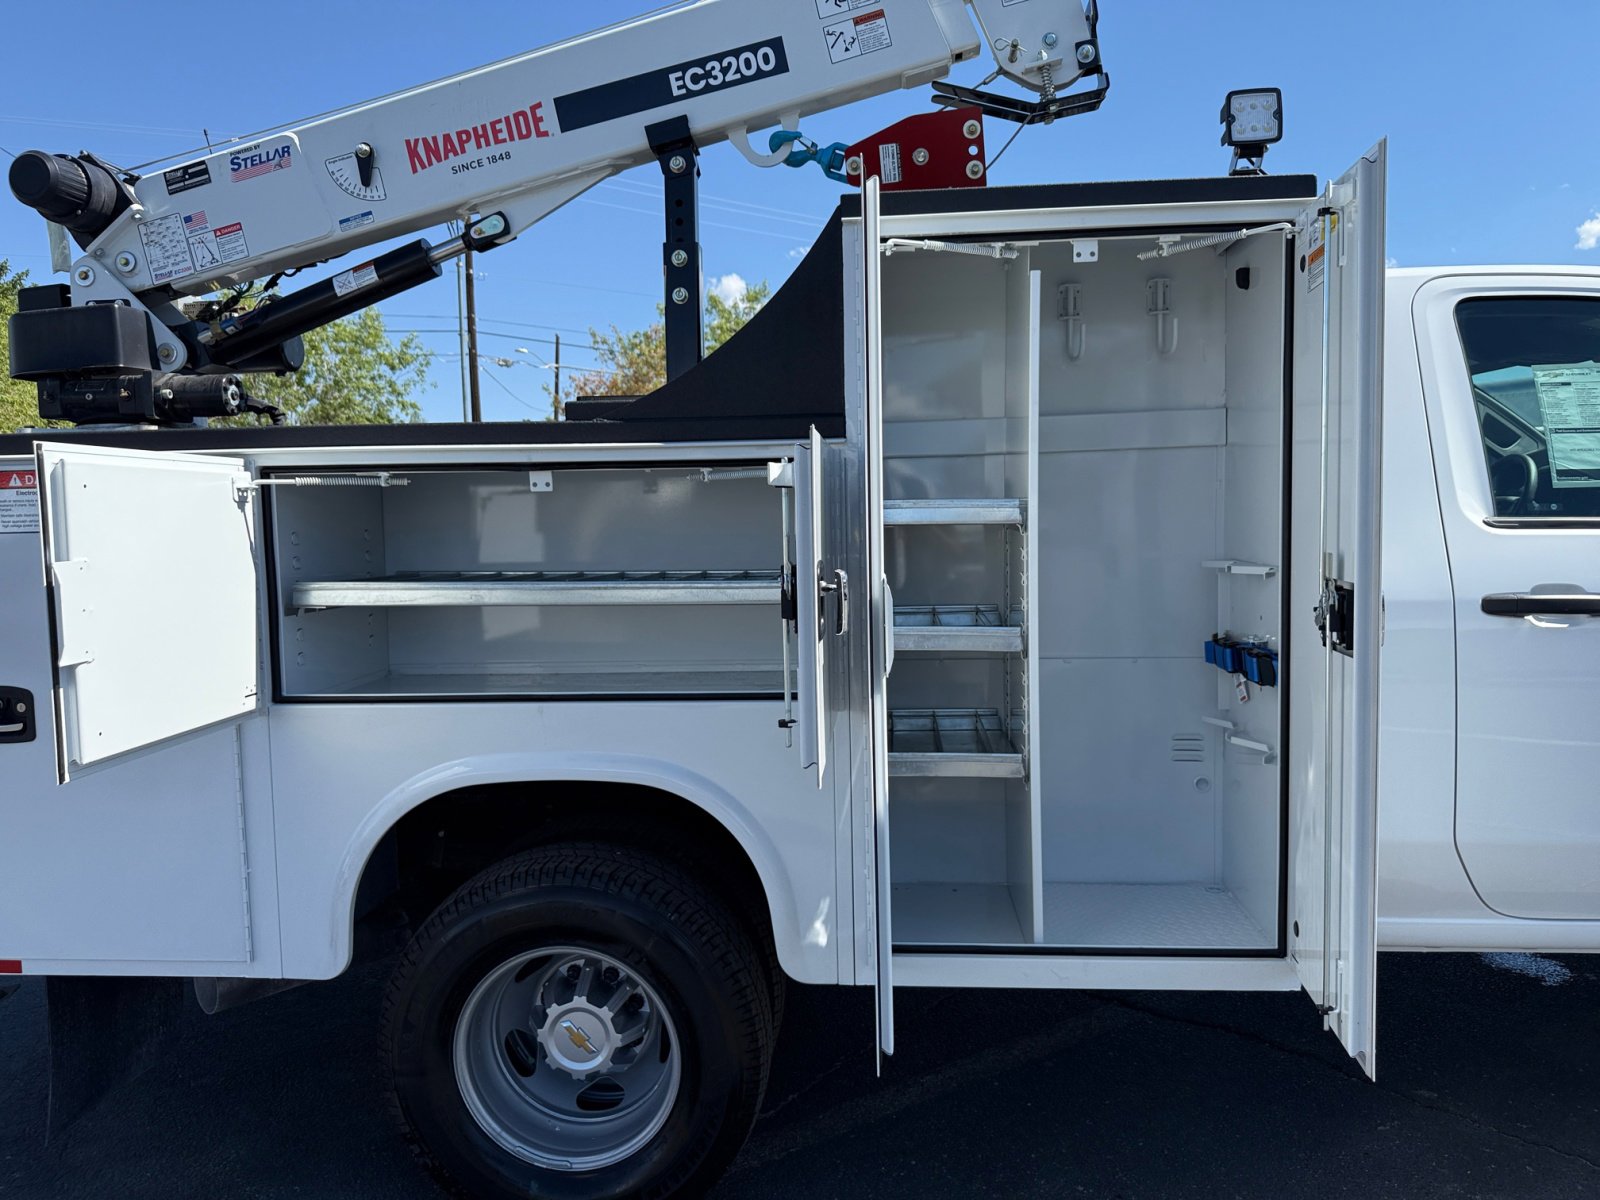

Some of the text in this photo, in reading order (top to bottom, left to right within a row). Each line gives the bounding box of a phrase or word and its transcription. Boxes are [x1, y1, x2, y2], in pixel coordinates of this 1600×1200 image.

[668, 46, 777, 97] EC3200
[404, 101, 550, 175] KNAPHEIDE
[229, 145, 254, 157] POWERED
[229, 145, 291, 172] STELLAR
[451, 151, 512, 175] SINCE 1848
[221, 225, 241, 235] DANGER
